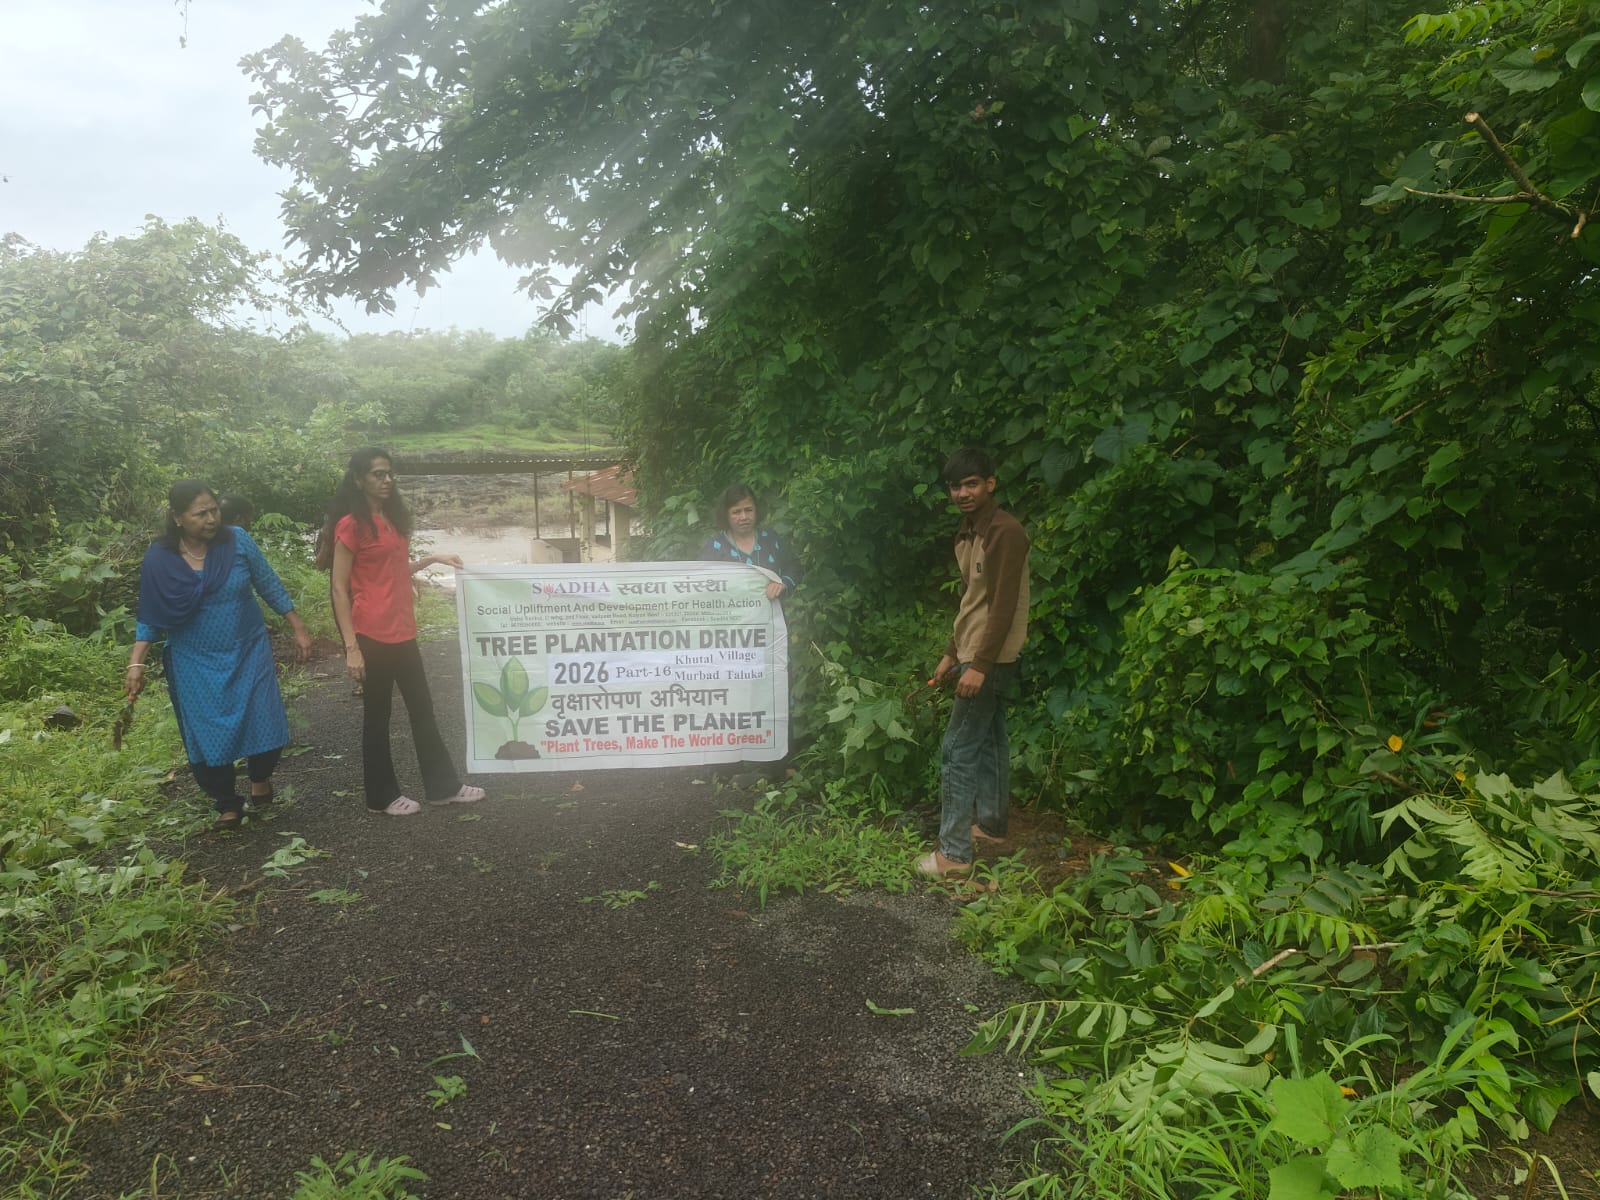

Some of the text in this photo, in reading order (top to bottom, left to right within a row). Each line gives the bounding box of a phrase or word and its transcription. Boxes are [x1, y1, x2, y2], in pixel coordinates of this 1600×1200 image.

[616, 576, 728, 596] स्वधा संस्था
[477, 598, 761, 615] Social Upliftment And Development For Health Action
[476, 628, 766, 657] TREE PLANTATION DRIVE
[675, 650, 756, 665] Khutal Village
[554, 661, 672, 684] 2026 Part-16
[674, 670, 763, 681] Murbad Taluka
[550, 683, 729, 719] वृक्षारोपण अभियान
[545, 711, 766, 737] SAVE THE PLANET
[540, 729, 771, 753] "Plant Trees, Make The World Green."
